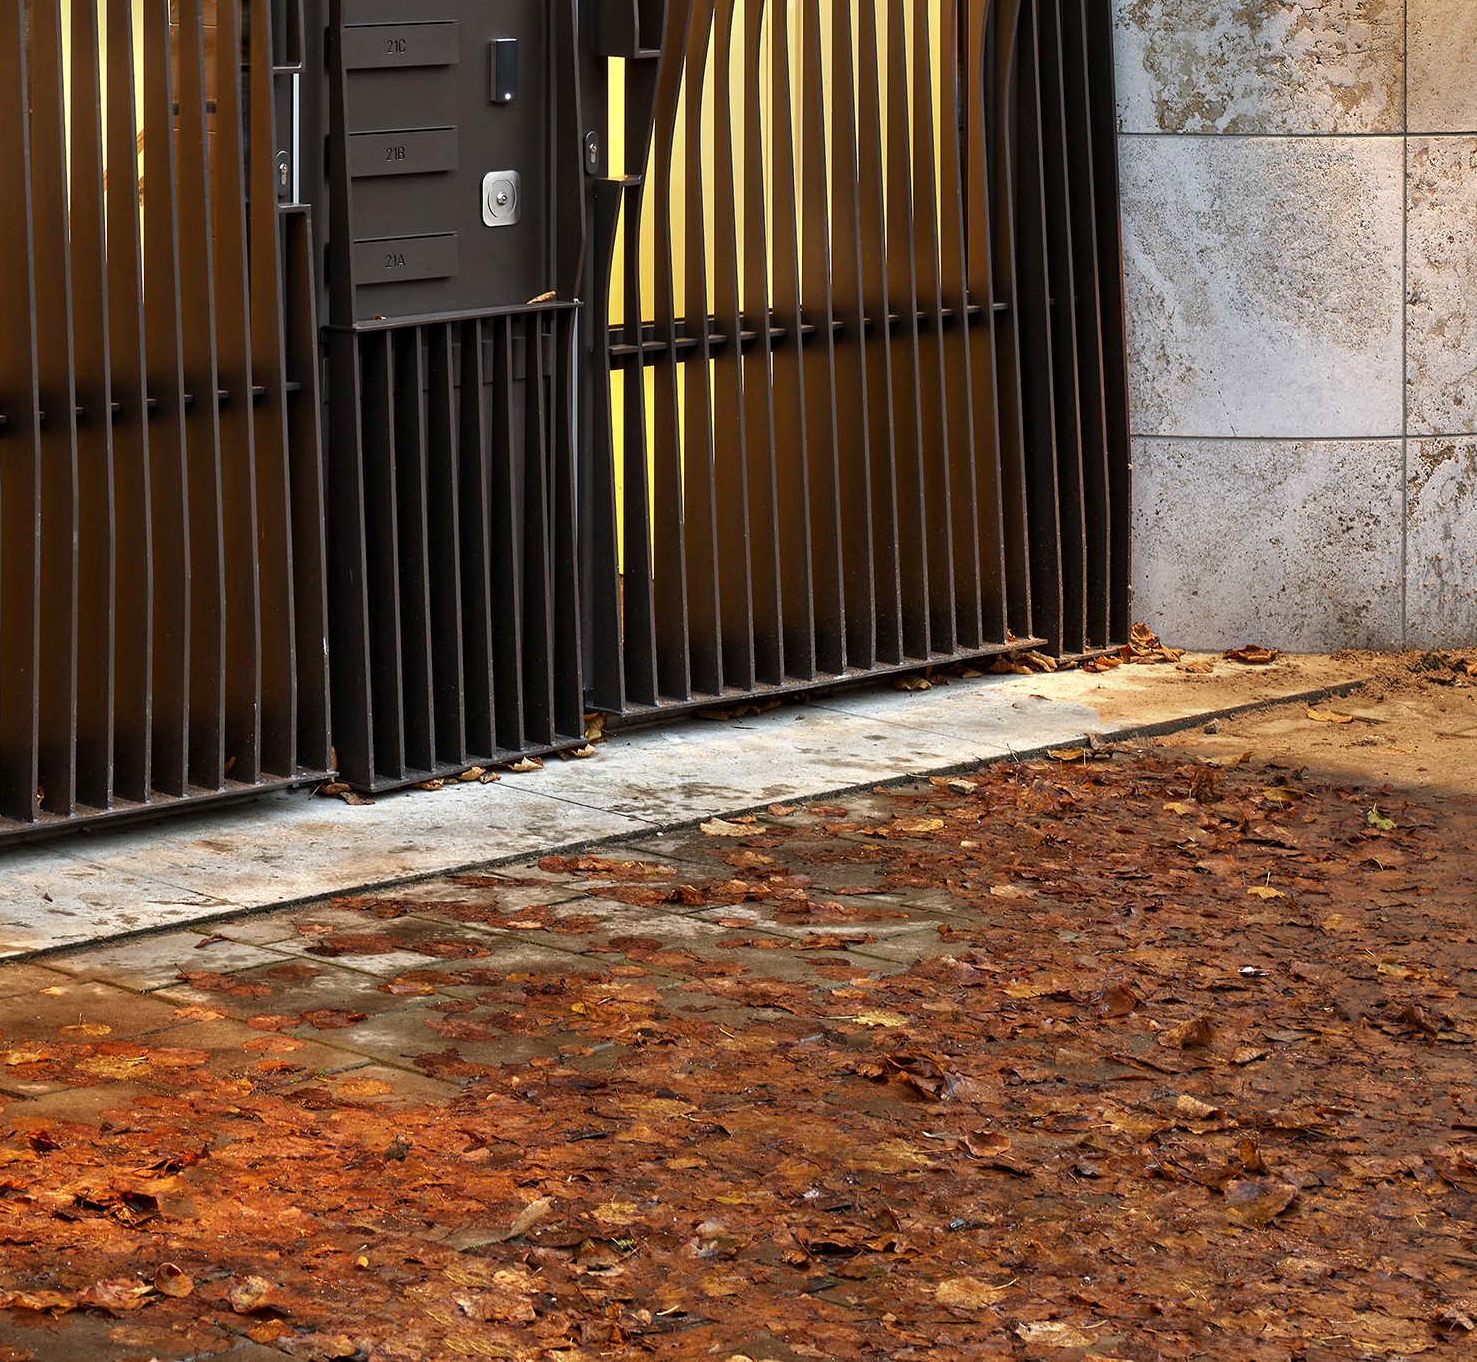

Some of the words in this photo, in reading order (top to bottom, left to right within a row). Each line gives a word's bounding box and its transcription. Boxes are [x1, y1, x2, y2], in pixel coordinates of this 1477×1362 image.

[387, 39, 406, 54] 21C
[386, 147, 406, 162] 21B
[385, 254, 406, 269] 21A
